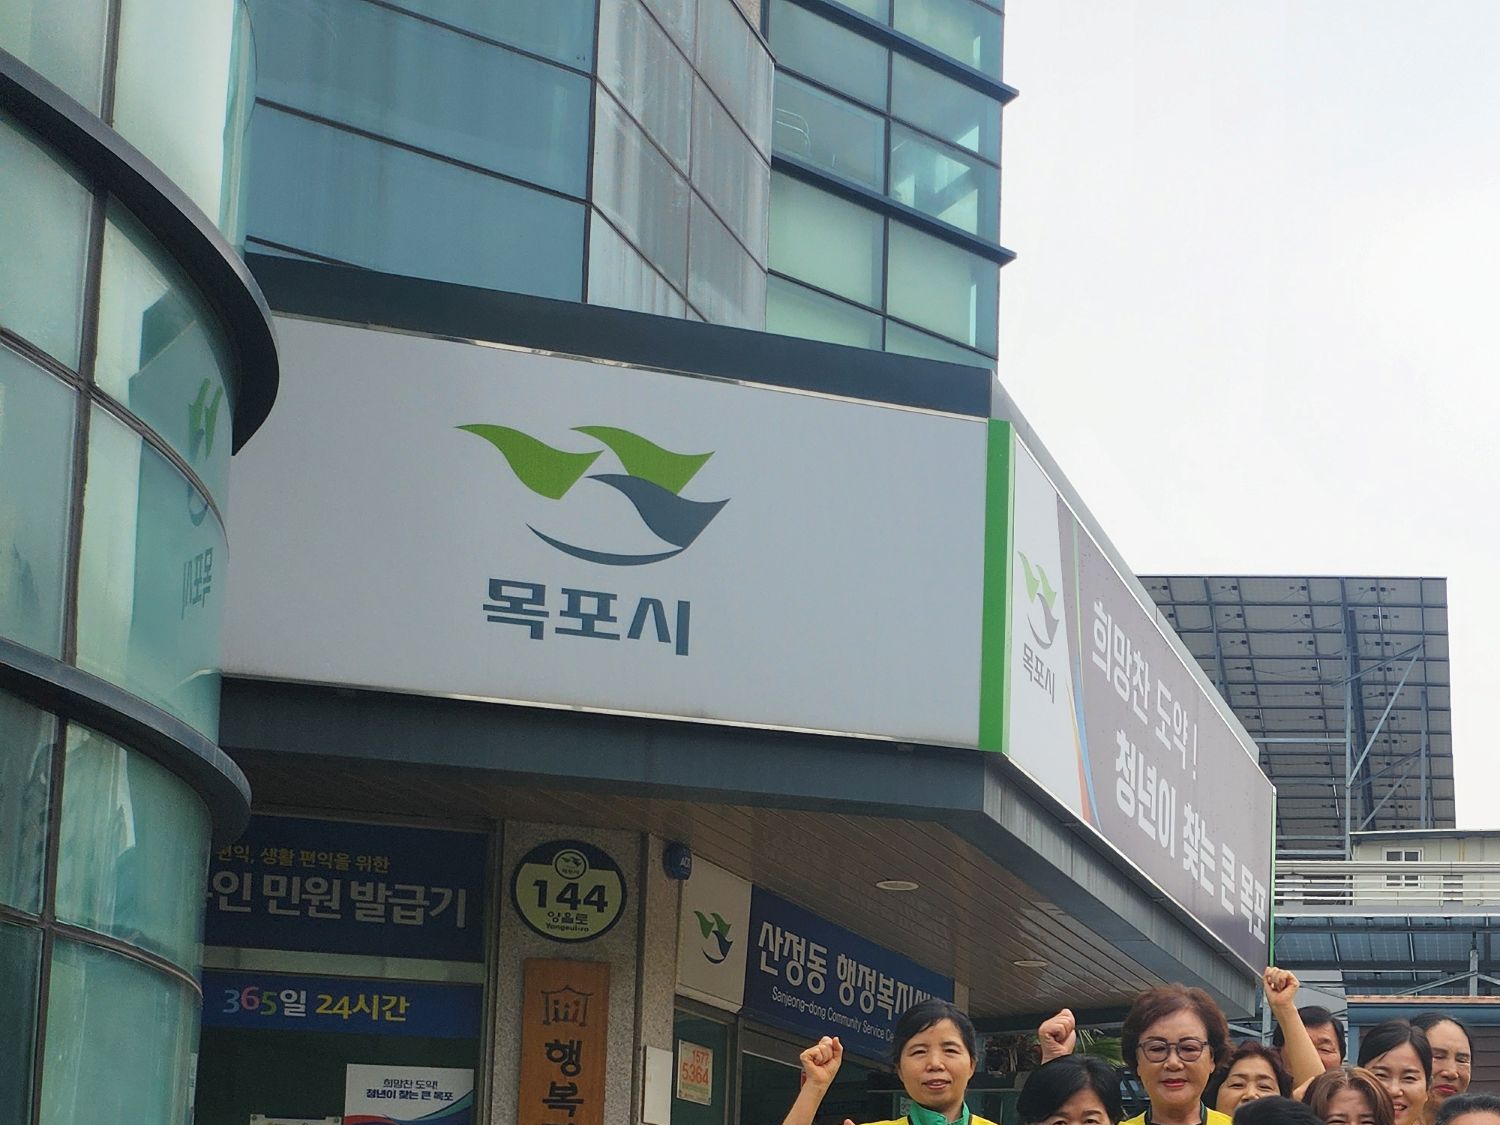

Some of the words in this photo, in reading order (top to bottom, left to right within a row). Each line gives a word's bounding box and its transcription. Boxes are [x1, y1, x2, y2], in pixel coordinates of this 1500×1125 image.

[482, 578, 692, 658] 목포시
[1023, 642, 1056, 704] 목포시
[1092, 600, 1151, 726] 희망찬
[1155, 678, 1199, 781] 도약!
[1115, 728, 1177, 858] 청년이
[1182, 801, 1216, 896] 찾는
[1220, 841, 1236, 915] 큰
[1239, 863, 1267, 945] 목포
[260, 848, 295, 867] 생활
[299, 850, 350, 872] 편익을
[355, 855, 391, 873] 위한
[207, 870, 253, 913] 인
[261, 872, 342, 921] 민원
[350, 879, 468, 929] 발급기
[532, 879, 609, 913] 144
[547, 911, 588, 925] 양을로
[758, 921, 828, 996] 산정동
[222, 986, 307, 1017] 365일
[316, 993, 411, 1022] 24시간
[771, 985, 827, 1020] Sanjeong-dong
[827, 1007, 863, 1033] Community
[862, 1018, 887, 1040] Service
[682, 1062, 709, 1085] 5364
[692, 1050, 710, 1066] 1577
[366, 1089, 397, 1101] 청년이
[383, 1079, 413, 1090] 희망찬
